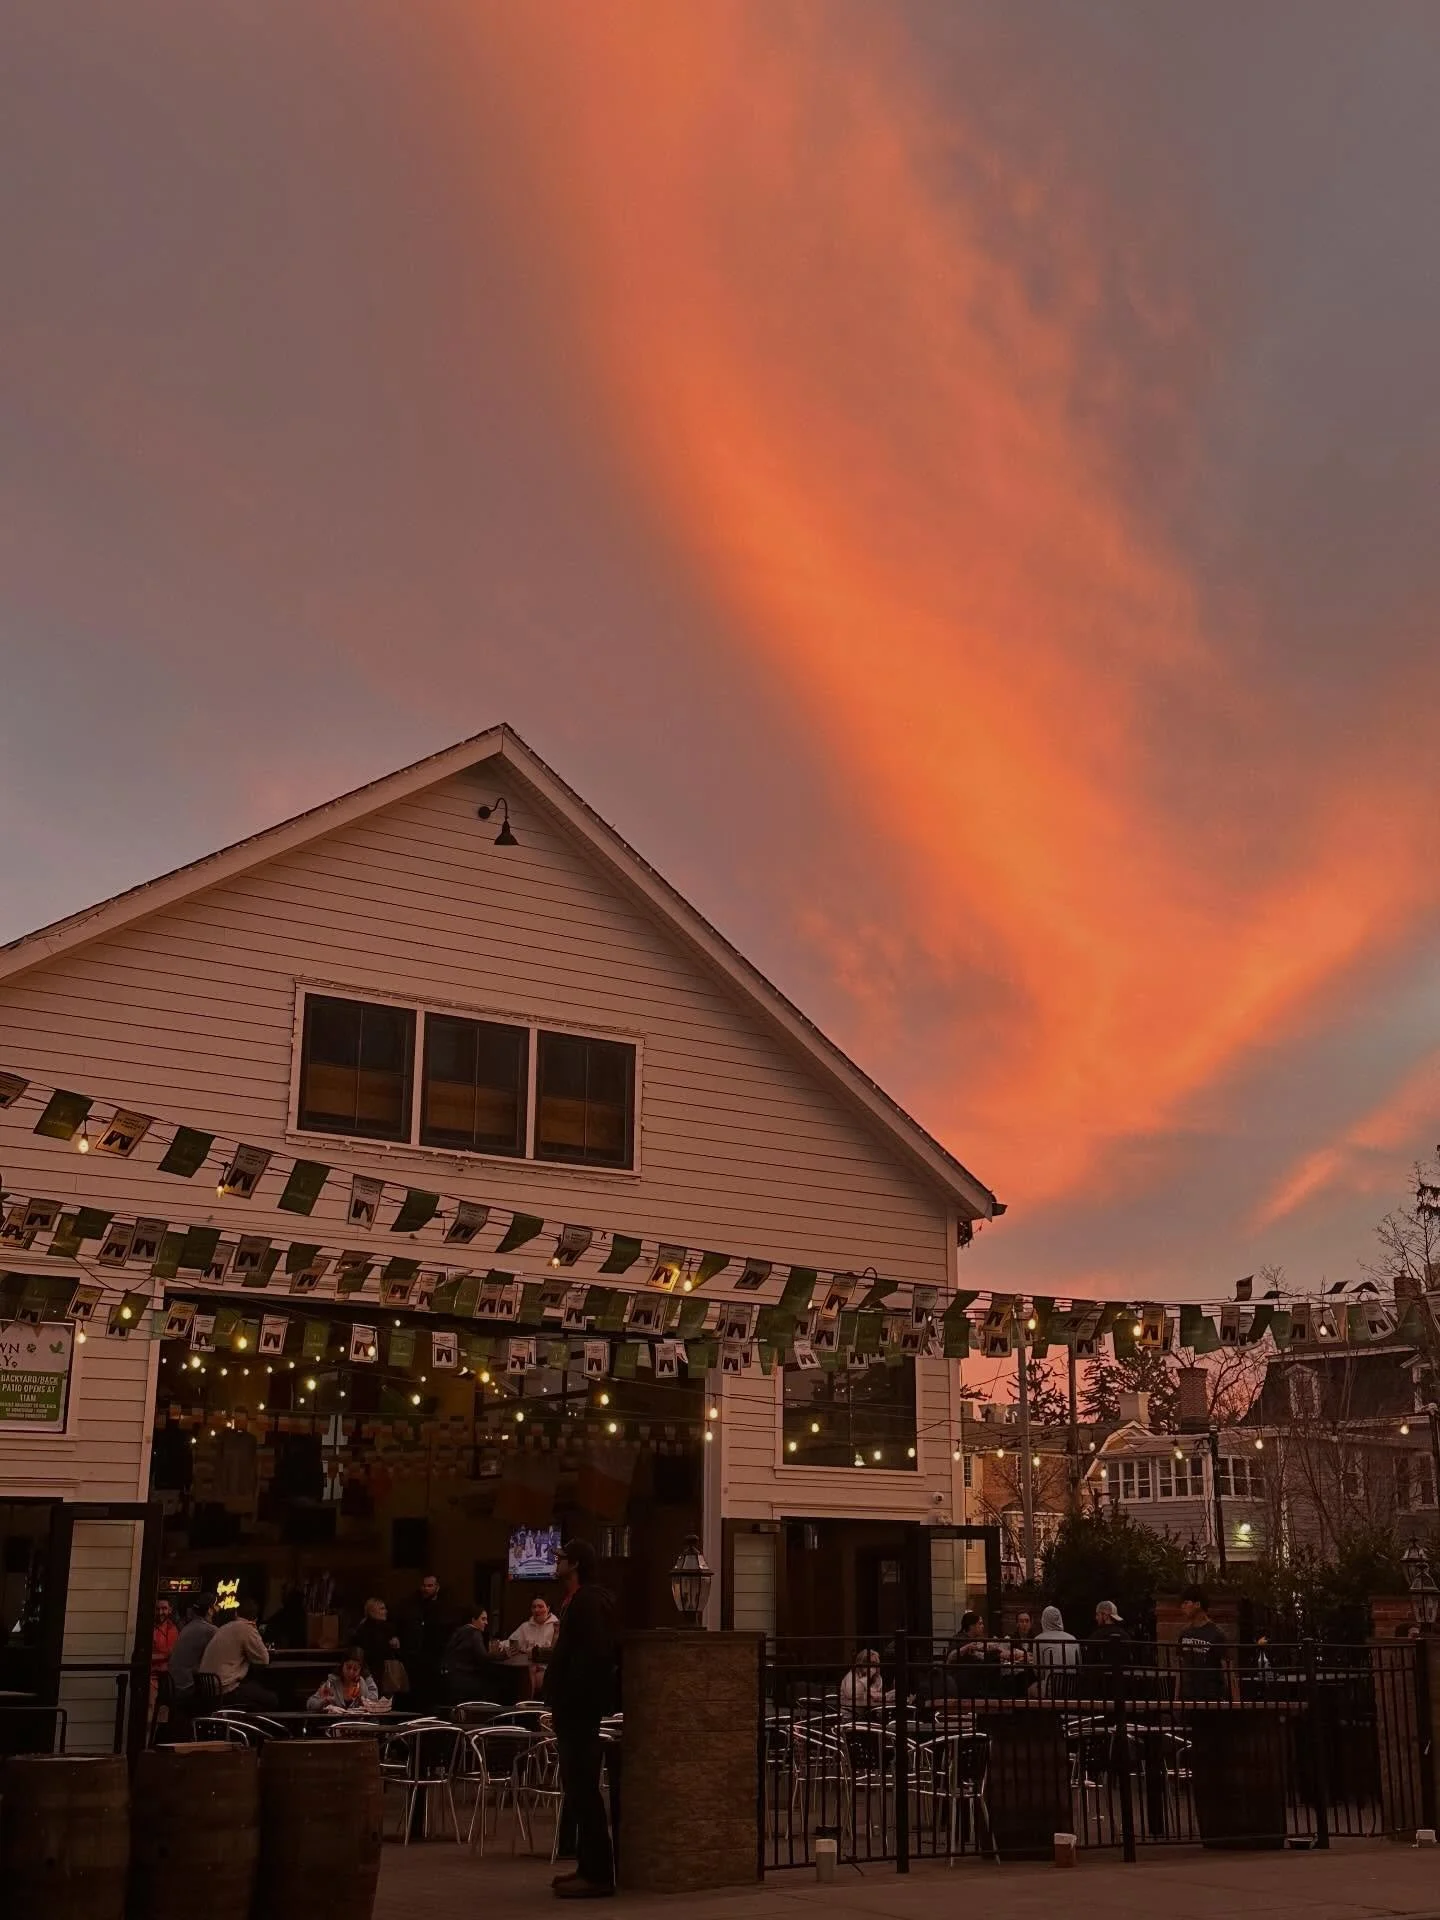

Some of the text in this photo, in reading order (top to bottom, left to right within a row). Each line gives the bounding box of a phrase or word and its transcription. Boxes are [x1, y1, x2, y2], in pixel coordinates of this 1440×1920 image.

[2, 1384, 56, 1393] PATIO OPENS AT
[20, 1394, 37, 1402] 11AM
